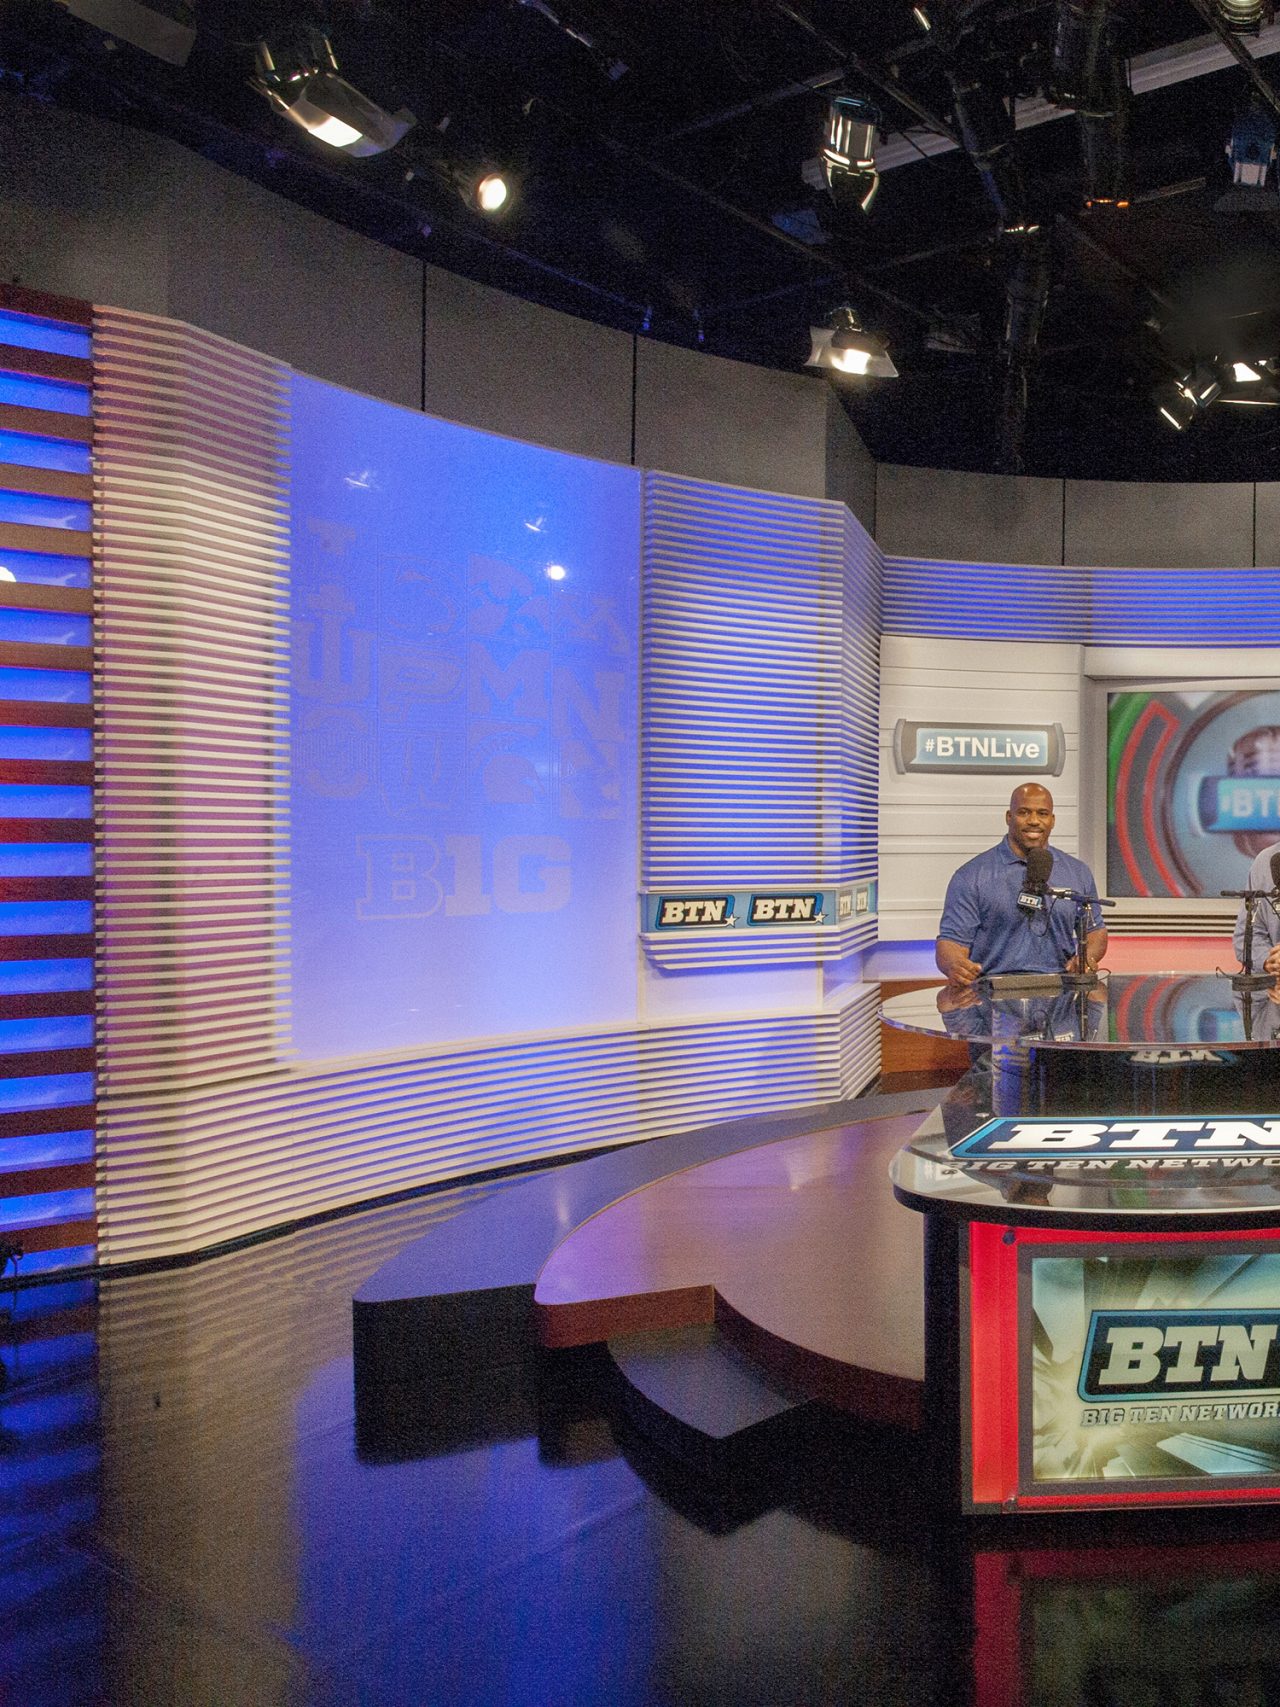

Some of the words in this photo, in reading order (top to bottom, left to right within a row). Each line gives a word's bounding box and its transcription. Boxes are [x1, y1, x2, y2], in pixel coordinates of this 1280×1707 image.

[924, 736, 1040, 759] #BTNLive
[661, 899, 726, 924] BTN
[753, 897, 815, 921] BTN
[1028, 1159, 1118, 1170] TEN
[1098, 1324, 1279, 1386] BTN
[1081, 1408, 1126, 1427] BIG
[1130, 1405, 1178, 1425] TEN
